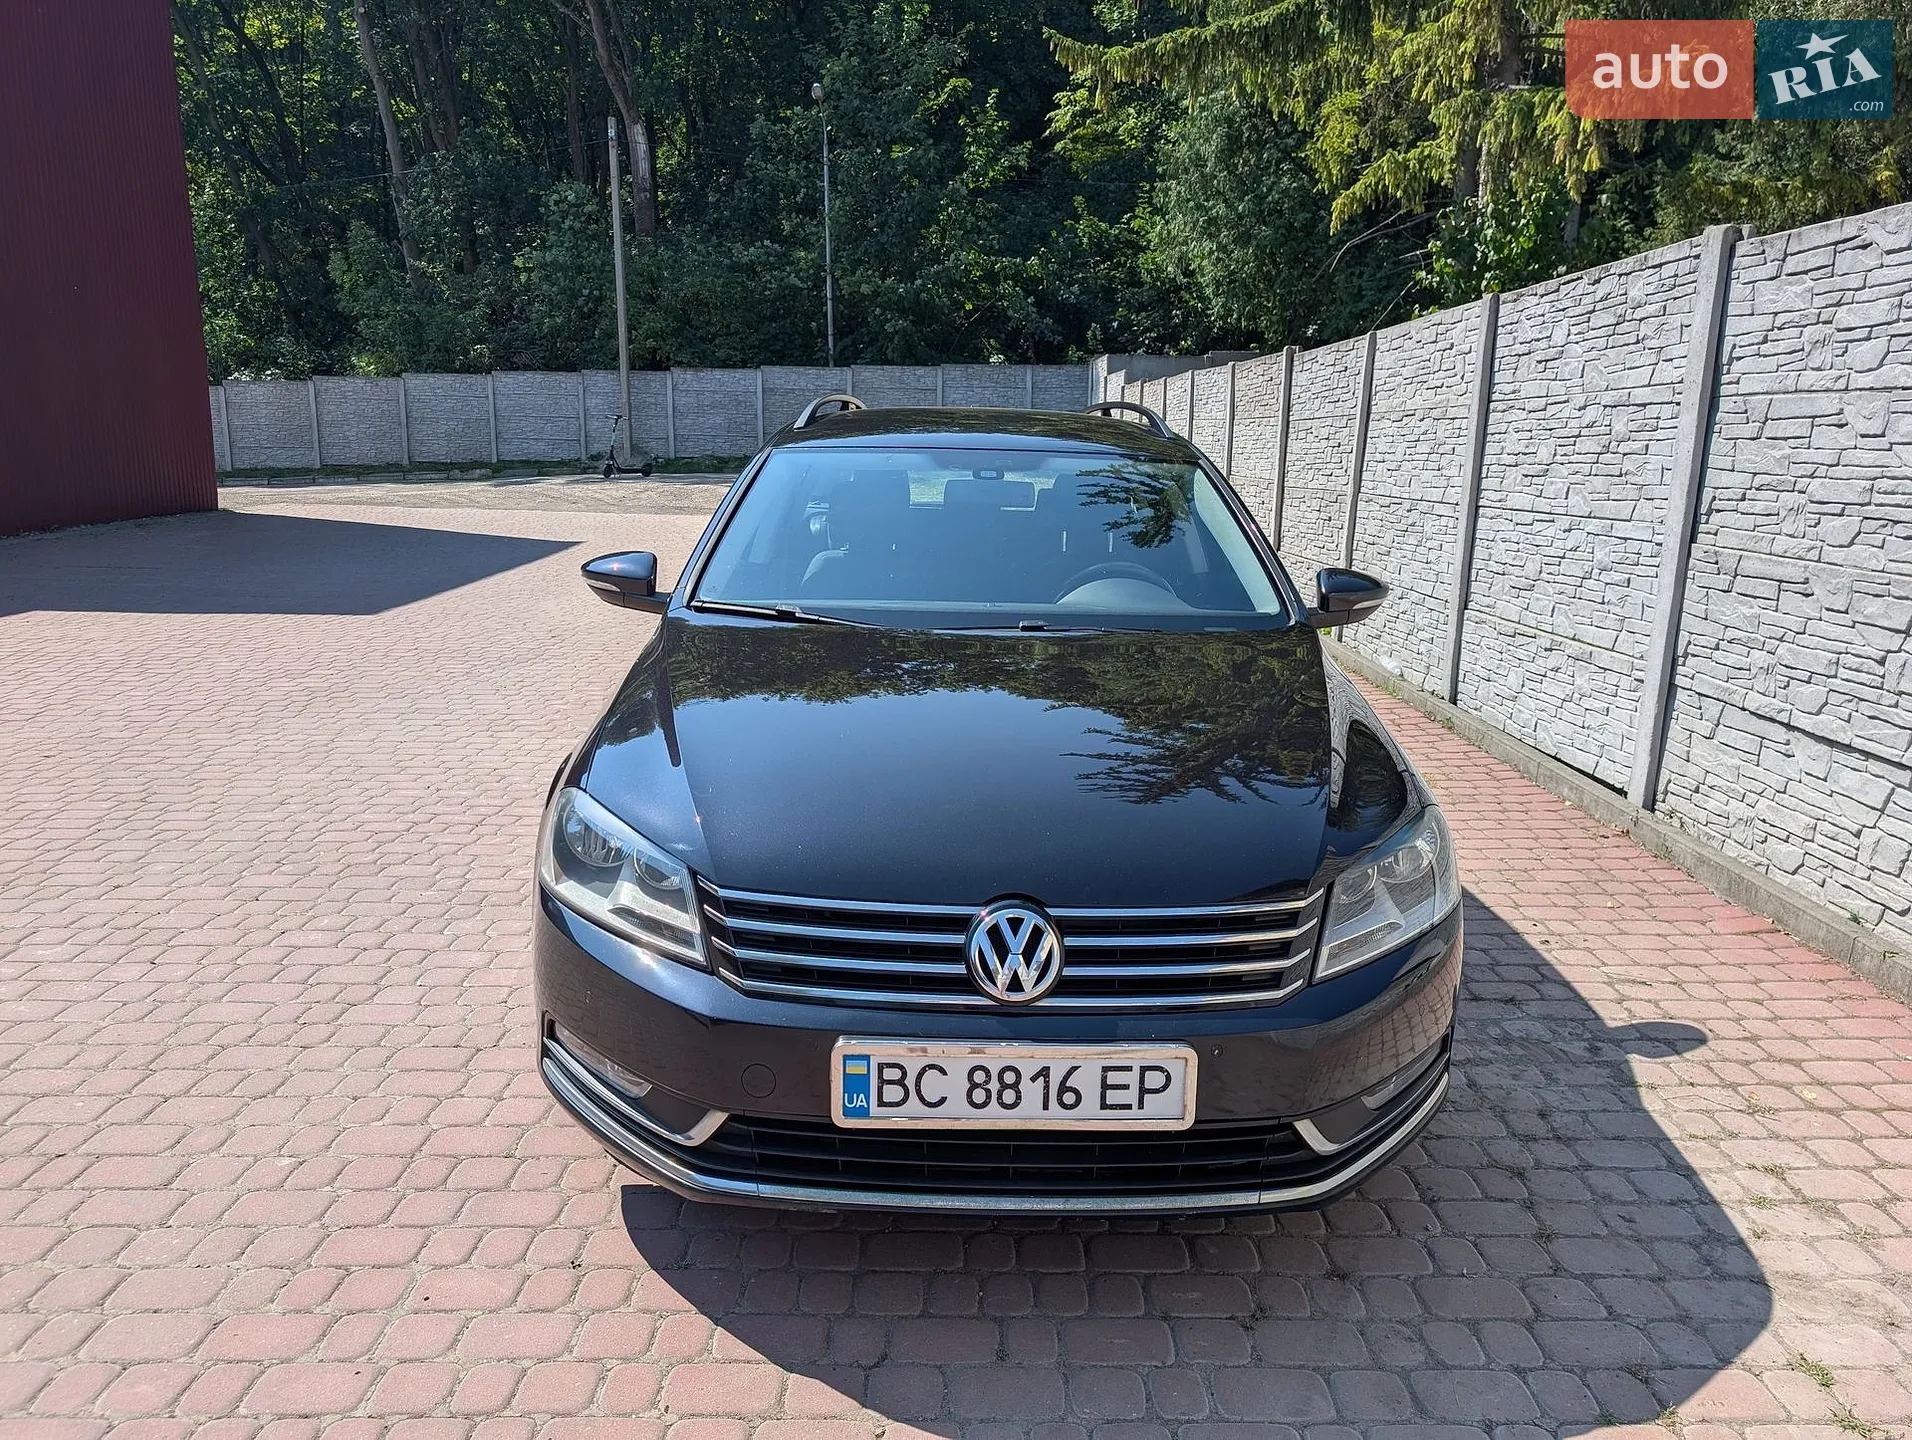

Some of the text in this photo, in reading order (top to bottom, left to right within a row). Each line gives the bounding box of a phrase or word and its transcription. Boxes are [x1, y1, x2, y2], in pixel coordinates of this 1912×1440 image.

[844, 1093, 868, 1108] UA
[876, 1062, 1172, 1111] BC 8816 EP
